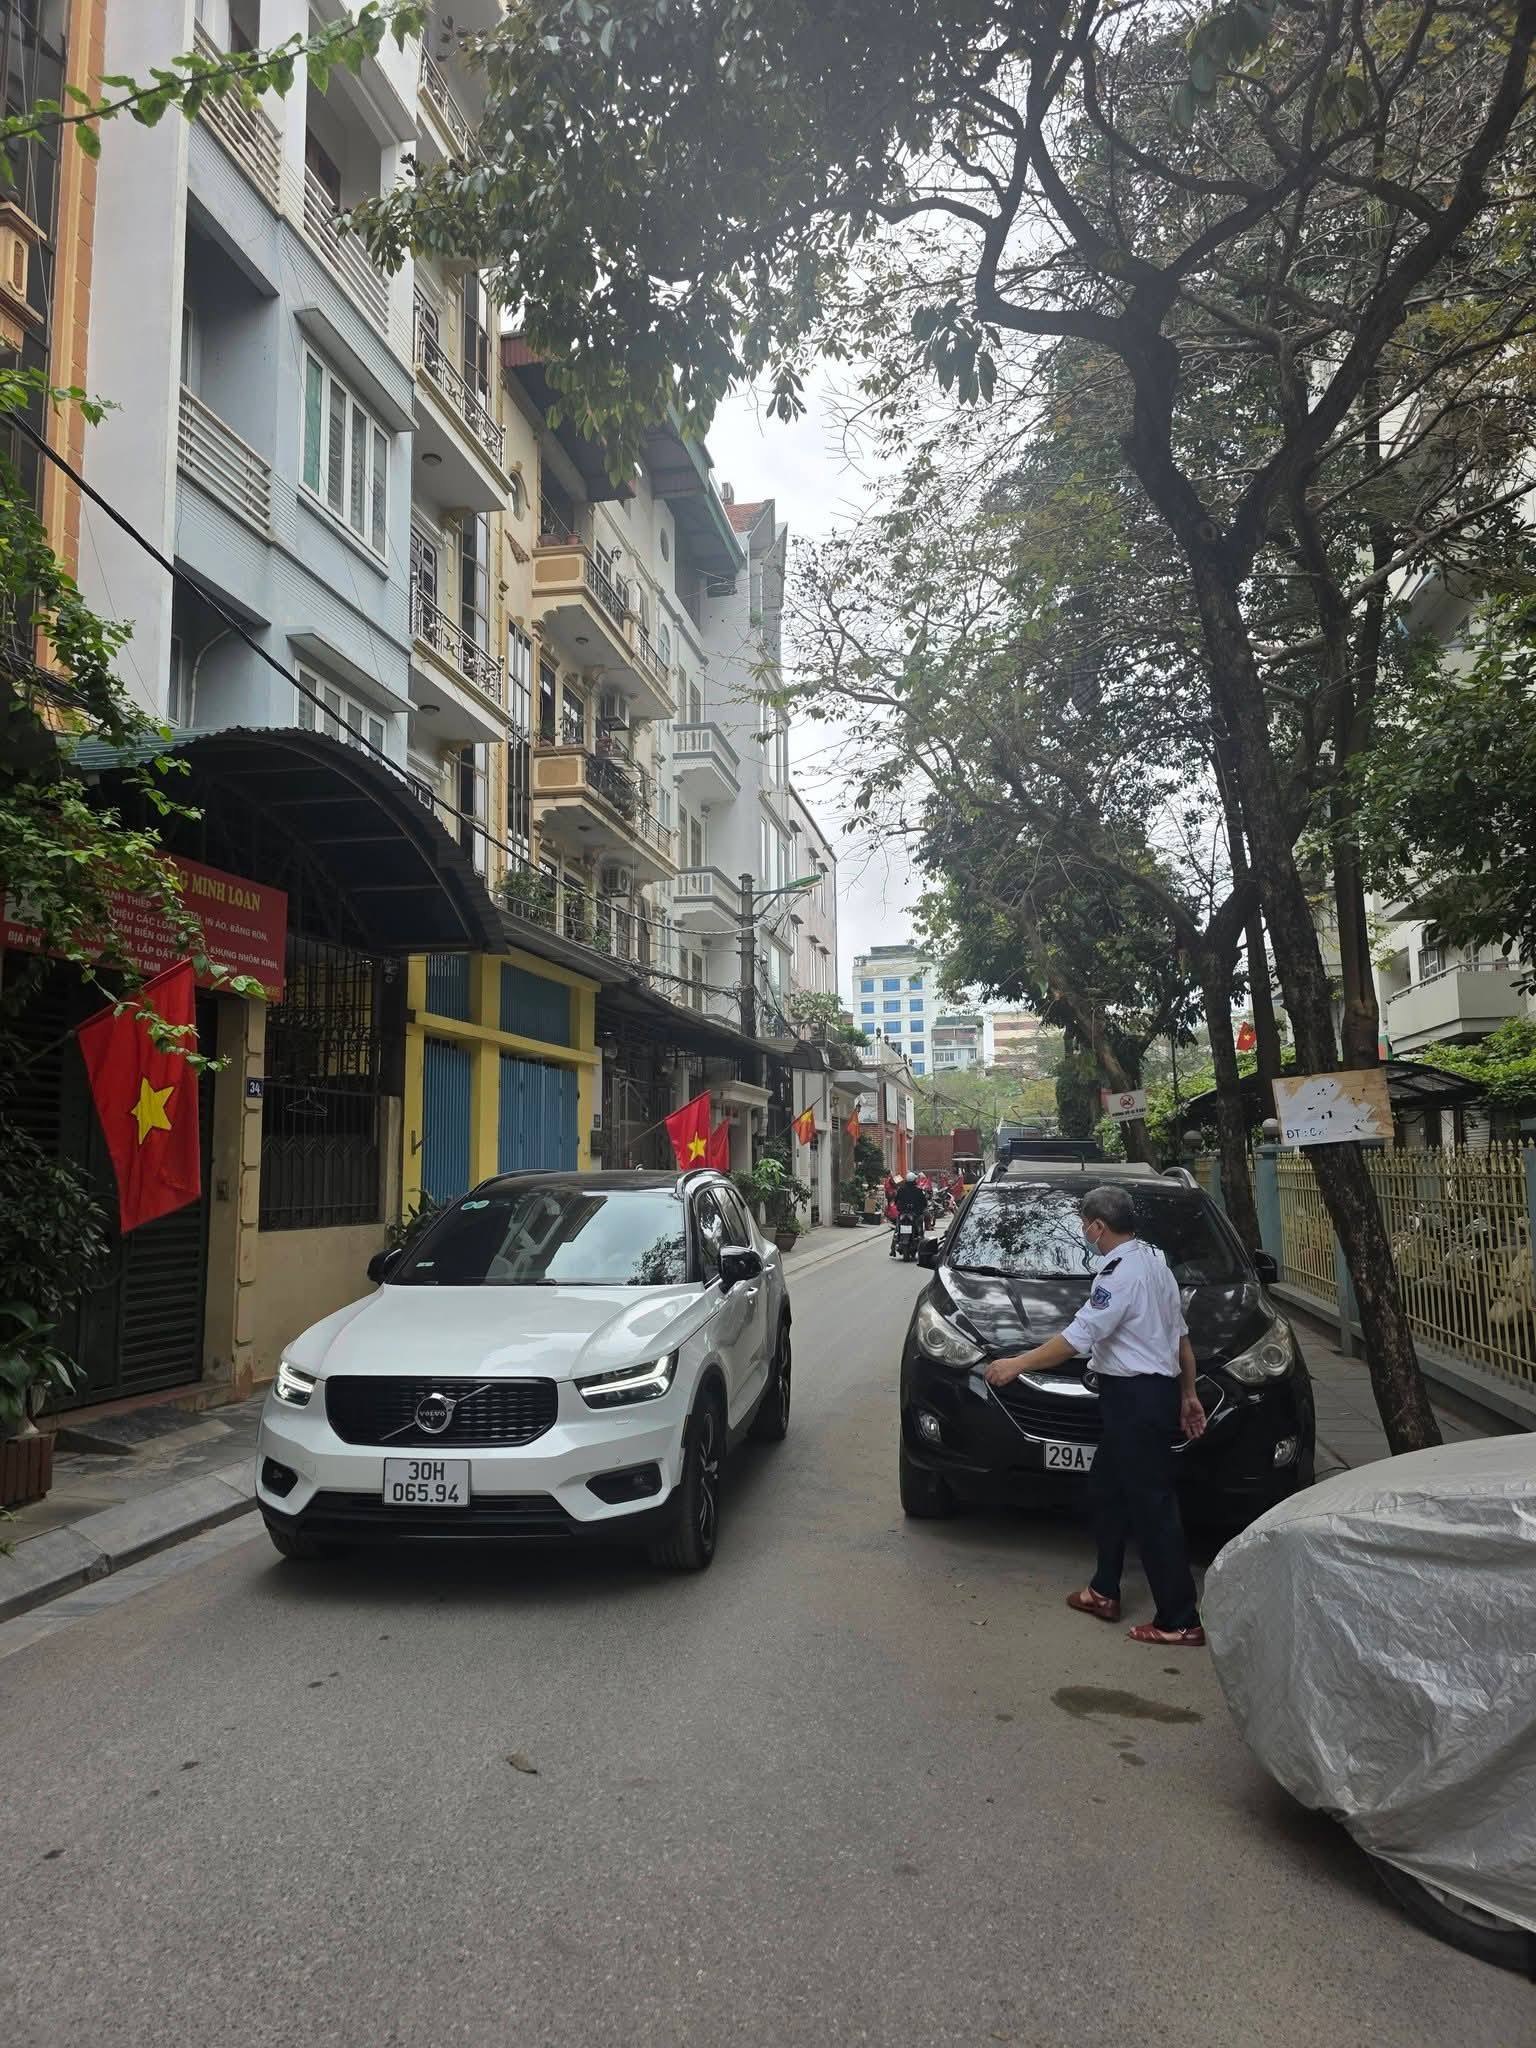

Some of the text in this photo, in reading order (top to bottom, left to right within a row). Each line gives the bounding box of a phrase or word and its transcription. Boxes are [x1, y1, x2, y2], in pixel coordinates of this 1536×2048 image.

[192, 874, 225, 901] MINH
[228, 885, 261, 912] LOAN
[408, 1461, 445, 1481] 30H
[392, 1483, 459, 1503] 065.94
